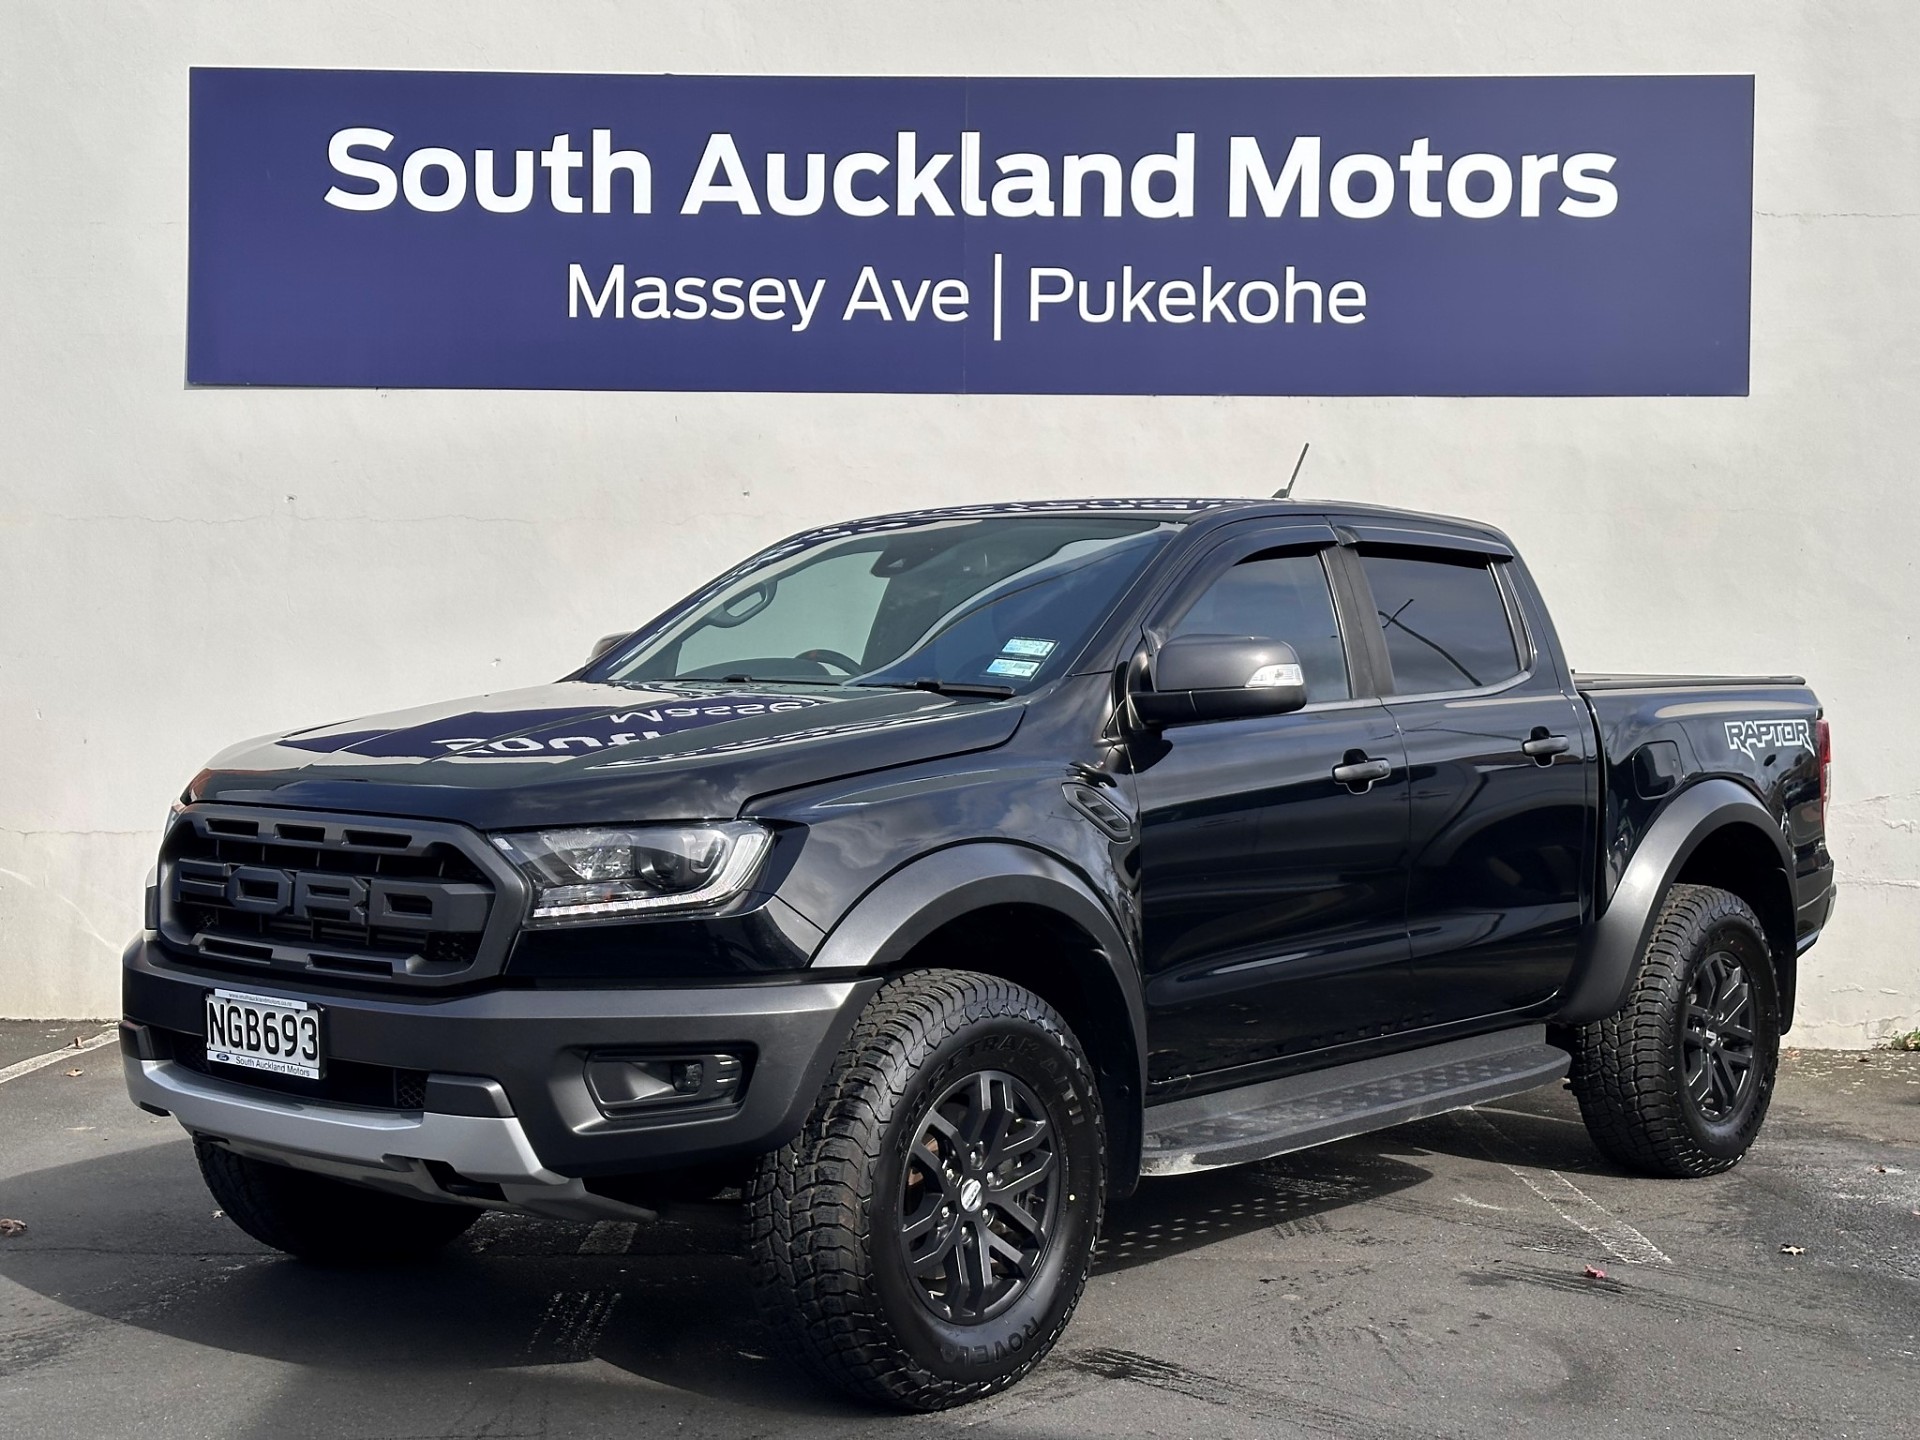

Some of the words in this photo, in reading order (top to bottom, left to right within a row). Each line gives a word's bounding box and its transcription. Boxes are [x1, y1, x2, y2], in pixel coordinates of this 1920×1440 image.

[324, 127, 652, 215] South
[680, 131, 1195, 219] Auckland
[1228, 136, 1619, 219] Motors
[568, 263, 826, 332] Massey
[842, 266, 970, 323] Ave
[1029, 265, 1367, 324] Pukekohe
[1723, 719, 1816, 761] RAPTOR
[178, 858, 455, 930] FORD
[209, 1003, 318, 1060] NGB693
[235, 1057, 254, 1066] South
[256, 1060, 285, 1072] Auckland
[288, 1066, 310, 1076] Motors
[939, 1316, 1042, 1367] ROVELO
